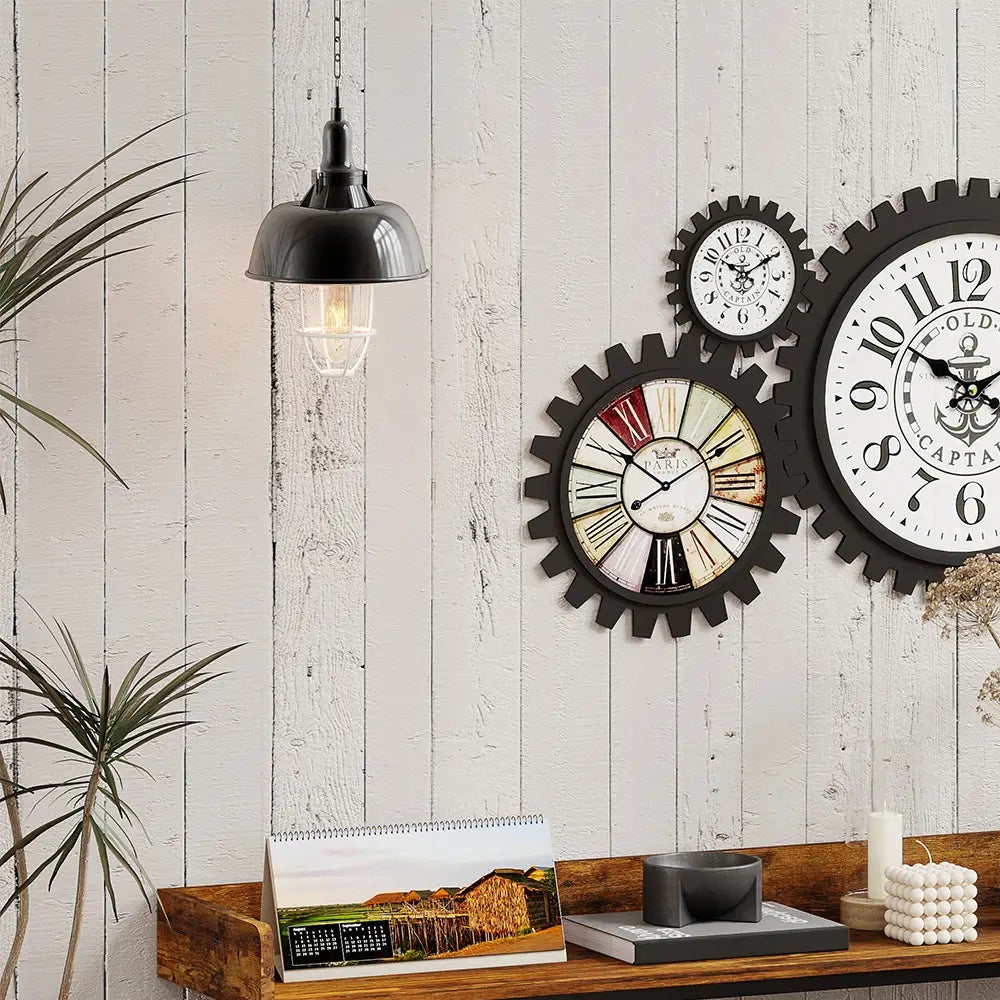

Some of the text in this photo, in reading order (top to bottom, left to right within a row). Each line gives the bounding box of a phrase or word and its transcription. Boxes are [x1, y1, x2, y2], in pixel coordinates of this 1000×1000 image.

[717, 232, 733, 251] 11
[735, 227, 751, 244] 12
[756, 232, 765, 248] 1
[703, 248, 720, 266] 10
[699, 271, 714, 283] 9
[771, 271, 786, 283] 3
[946, 257, 993, 304] 12
[704, 290, 719, 305] 8
[724, 290, 762, 304] CAPTAIN
[895, 271, 945, 324] 11
[720, 302, 731, 319] 7
[737, 307, 749, 325] 6
[755, 302, 767, 319] 5
[946, 312, 994, 332] OLD
[857, 316, 906, 368] 10
[849, 380, 890, 411] 9
[611, 397, 651, 447] XI
[862, 434, 902, 472] 8
[644, 459, 689, 470] PARIS
[575, 480, 617, 501] IX
[714, 473, 756, 492] III
[907, 467, 940, 513] 7
[955, 481, 986, 526] 6
[706, 503, 747, 541] IV
[690, 529, 717, 572] V
